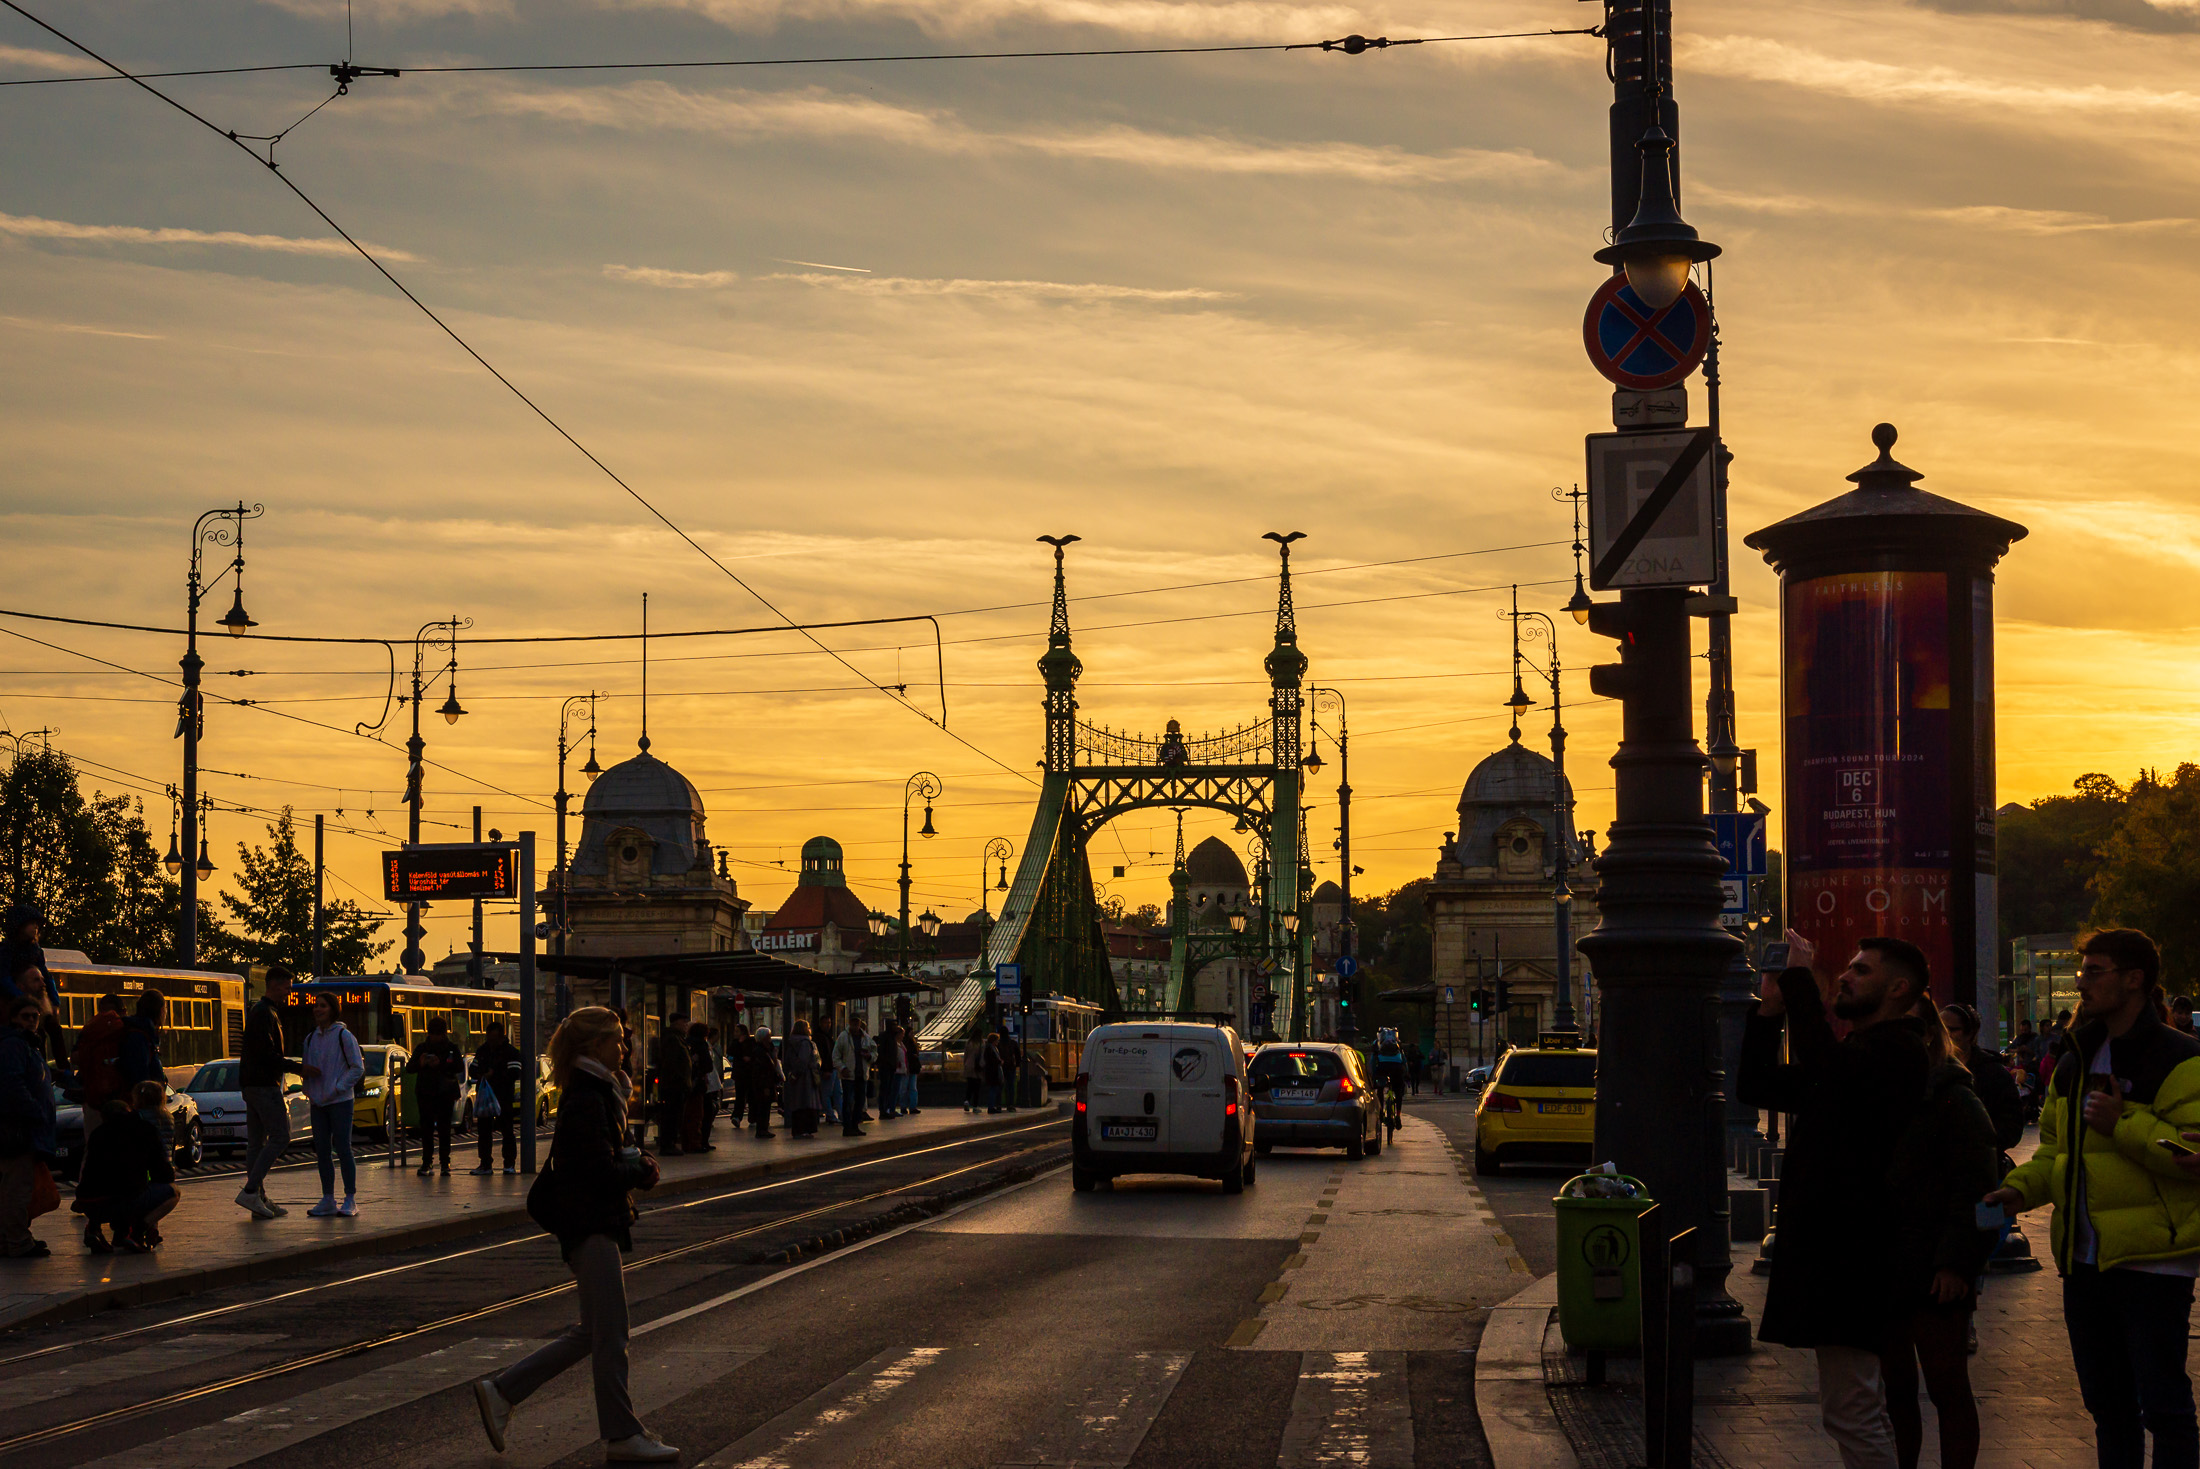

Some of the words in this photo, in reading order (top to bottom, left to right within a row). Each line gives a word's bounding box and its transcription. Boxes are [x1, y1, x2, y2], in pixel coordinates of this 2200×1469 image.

[1623, 554, 1685, 577] ZÓNA
[1816, 581, 1904, 596] FAITHLESS
[1804, 755, 1838, 767] CHAMPION
[1841, 754, 1869, 763] SOUND
[1874, 754, 1897, 762] TOUR
[1902, 754, 1924, 762] 2024
[1843, 771, 1872, 787] DEC
[1851, 787, 1862, 803] 6
[1823, 809, 1872, 820] BUDAPEST,
[1875, 808, 1896, 818] HUN
[1830, 820, 1857, 830] BARBA
[1858, 819, 1887, 828] NEGRA
[1863, 874, 1950, 886] DRAGONS
[1722, 915, 1728, 924] 3
[1881, 916, 1950, 928] TOUR
[751, 929, 815, 950] GELLÉRT
[1543, 1036, 1561, 1044] Uber
[1544, 1104, 1583, 1112] EDF-038
